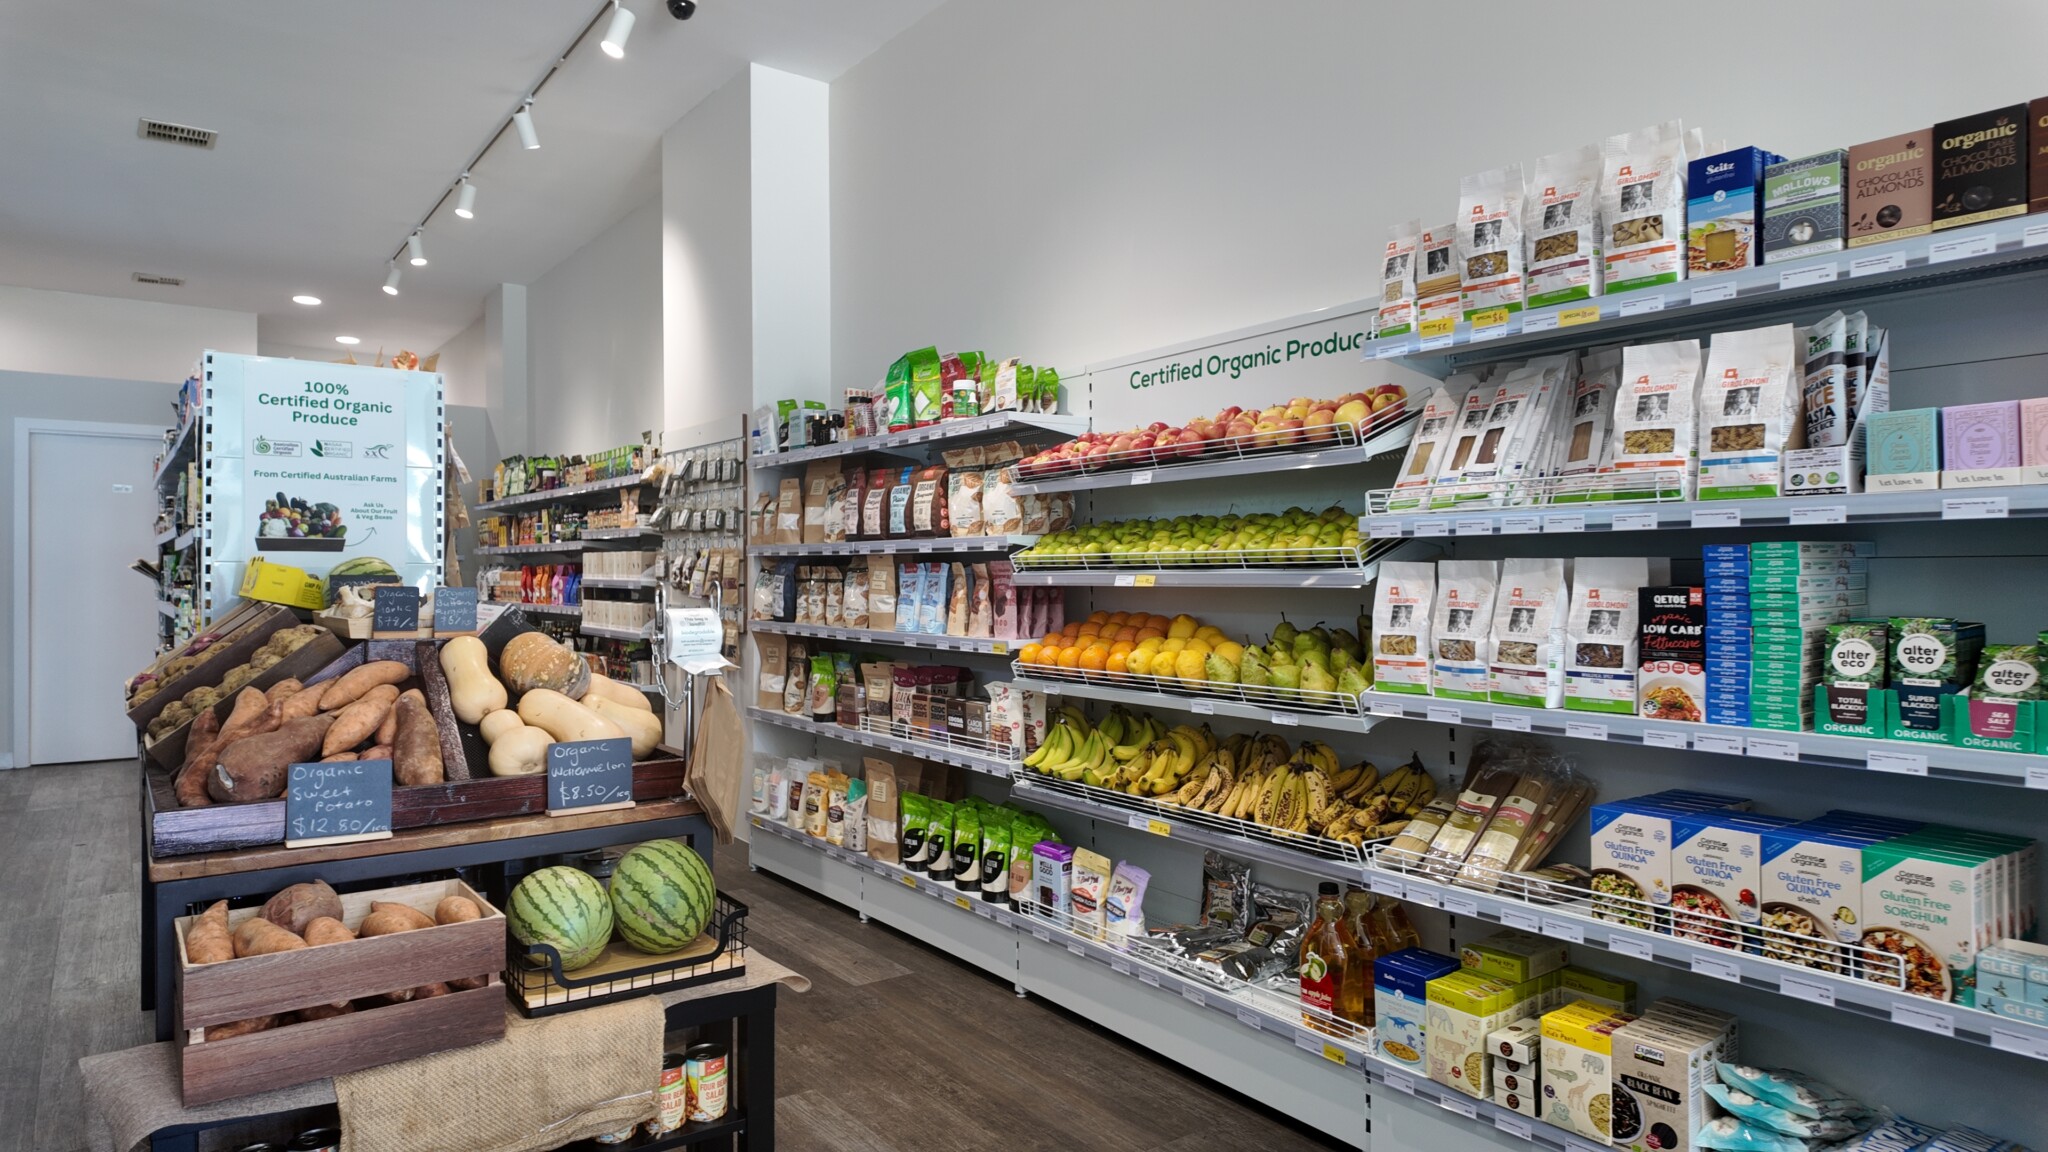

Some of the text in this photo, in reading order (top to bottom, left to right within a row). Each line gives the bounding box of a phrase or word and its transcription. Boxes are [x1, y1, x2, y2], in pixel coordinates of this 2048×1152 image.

[1941, 123, 2017, 150] organic
[1987, 136, 2016, 149] DARK
[1856, 147, 1924, 171] organic
[1941, 145, 2016, 168] CHOCOLATE
[1705, 162, 1735, 175] Seitz
[1783, 159, 1819, 175] organic
[1941, 154, 2016, 179] ALMONDS
[1616, 170, 1662, 185] GIROLOMONI
[1856, 167, 1923, 188] CHOCOLATE
[1772, 176, 1831, 198] MALLOWS
[1856, 176, 1924, 199] ALMONDS
[1940, 215, 1982, 227] ORGANIC
[1855, 233, 1893, 245] ORGANIC
[1130, 358, 1203, 390] Certified
[1206, 344, 1281, 380] Organic
[304, 381, 349, 396] 100%
[1634, 384, 1678, 394] GIROLOMONI
[1721, 377, 1770, 389] GIROLOMONI
[258, 393, 393, 414] Certified Organic
[1808, 386, 1836, 408] ICE
[292, 410, 358, 426] Produce
[1807, 405, 1836, 425] ASTA
[253, 470, 398, 483] From Certified Australian Farms
[1894, 478, 1913, 486] Love
[1913, 477, 1924, 485] In
[1972, 474, 1992, 483] Love
[1994, 473, 2005, 481] In
[1651, 614, 1693, 624] organic
[1643, 624, 1703, 635] LOW CARB
[1837, 649, 1870, 660] alter
[1903, 646, 1939, 657] alter
[1841, 658, 1866, 668] eco
[1908, 655, 1935, 665] eco
[1991, 669, 2031, 680] alter
[1994, 677, 2023, 687] eco
[1837, 697, 1864, 705] TOTAL
[1908, 695, 1936, 703] SUPER
[930, 704, 946, 714] CHOC
[1991, 711, 2010, 719] SEA
[1988, 717, 2011, 725] SALT
[1823, 723, 1875, 735] ORGANIC
[1894, 729, 1948, 742] ORGANIC
[1962, 737, 2022, 751] ORGANIC
[554, 742, 610, 767] Organic
[293, 765, 364, 790] Organic
[292, 785, 352, 801] Sweet
[314, 799, 373, 813] Potato
[1614, 828, 1644, 838] Organics
[1617, 823, 1637, 832] Ceres
[1697, 842, 1730, 853] Organics
[1700, 837, 1722, 846] Ceres
[1604, 840, 1656, 858] Gluten Free
[1611, 851, 1647, 864] QUINOA
[1685, 855, 1743, 873] Gluten Free
[1790, 857, 1827, 869] Organics
[1794, 852, 1819, 863] Ceres
[1618, 862, 1640, 871] penne
[1693, 866, 1734, 881] QUINOA
[1898, 870, 1926, 881] Ceres
[1701, 877, 1726, 888] spirals
[1777, 871, 1842, 891] Gluten Free
[1894, 875, 1935, 888] Organics
[1786, 883, 1832, 899] QUINOA
[1797, 895, 1821, 906] shells
[1879, 889, 1952, 911] Gluten Free
[1883, 905, 1948, 926] SORGHUM
[1900, 919, 1930, 931] spirals
[1979, 958, 2021, 976] GLEE
[2003, 1003, 2044, 1021] GLEE
[1635, 1044, 1664, 1059] Explore
[700, 1081, 716, 1091] FOUR
[1627, 1079, 1673, 1100] BLACK BEAN
[660, 1092, 672, 1101] OUR
[705, 1087, 725, 1099] SALAD
[661, 1098, 682, 1111] SALAD
